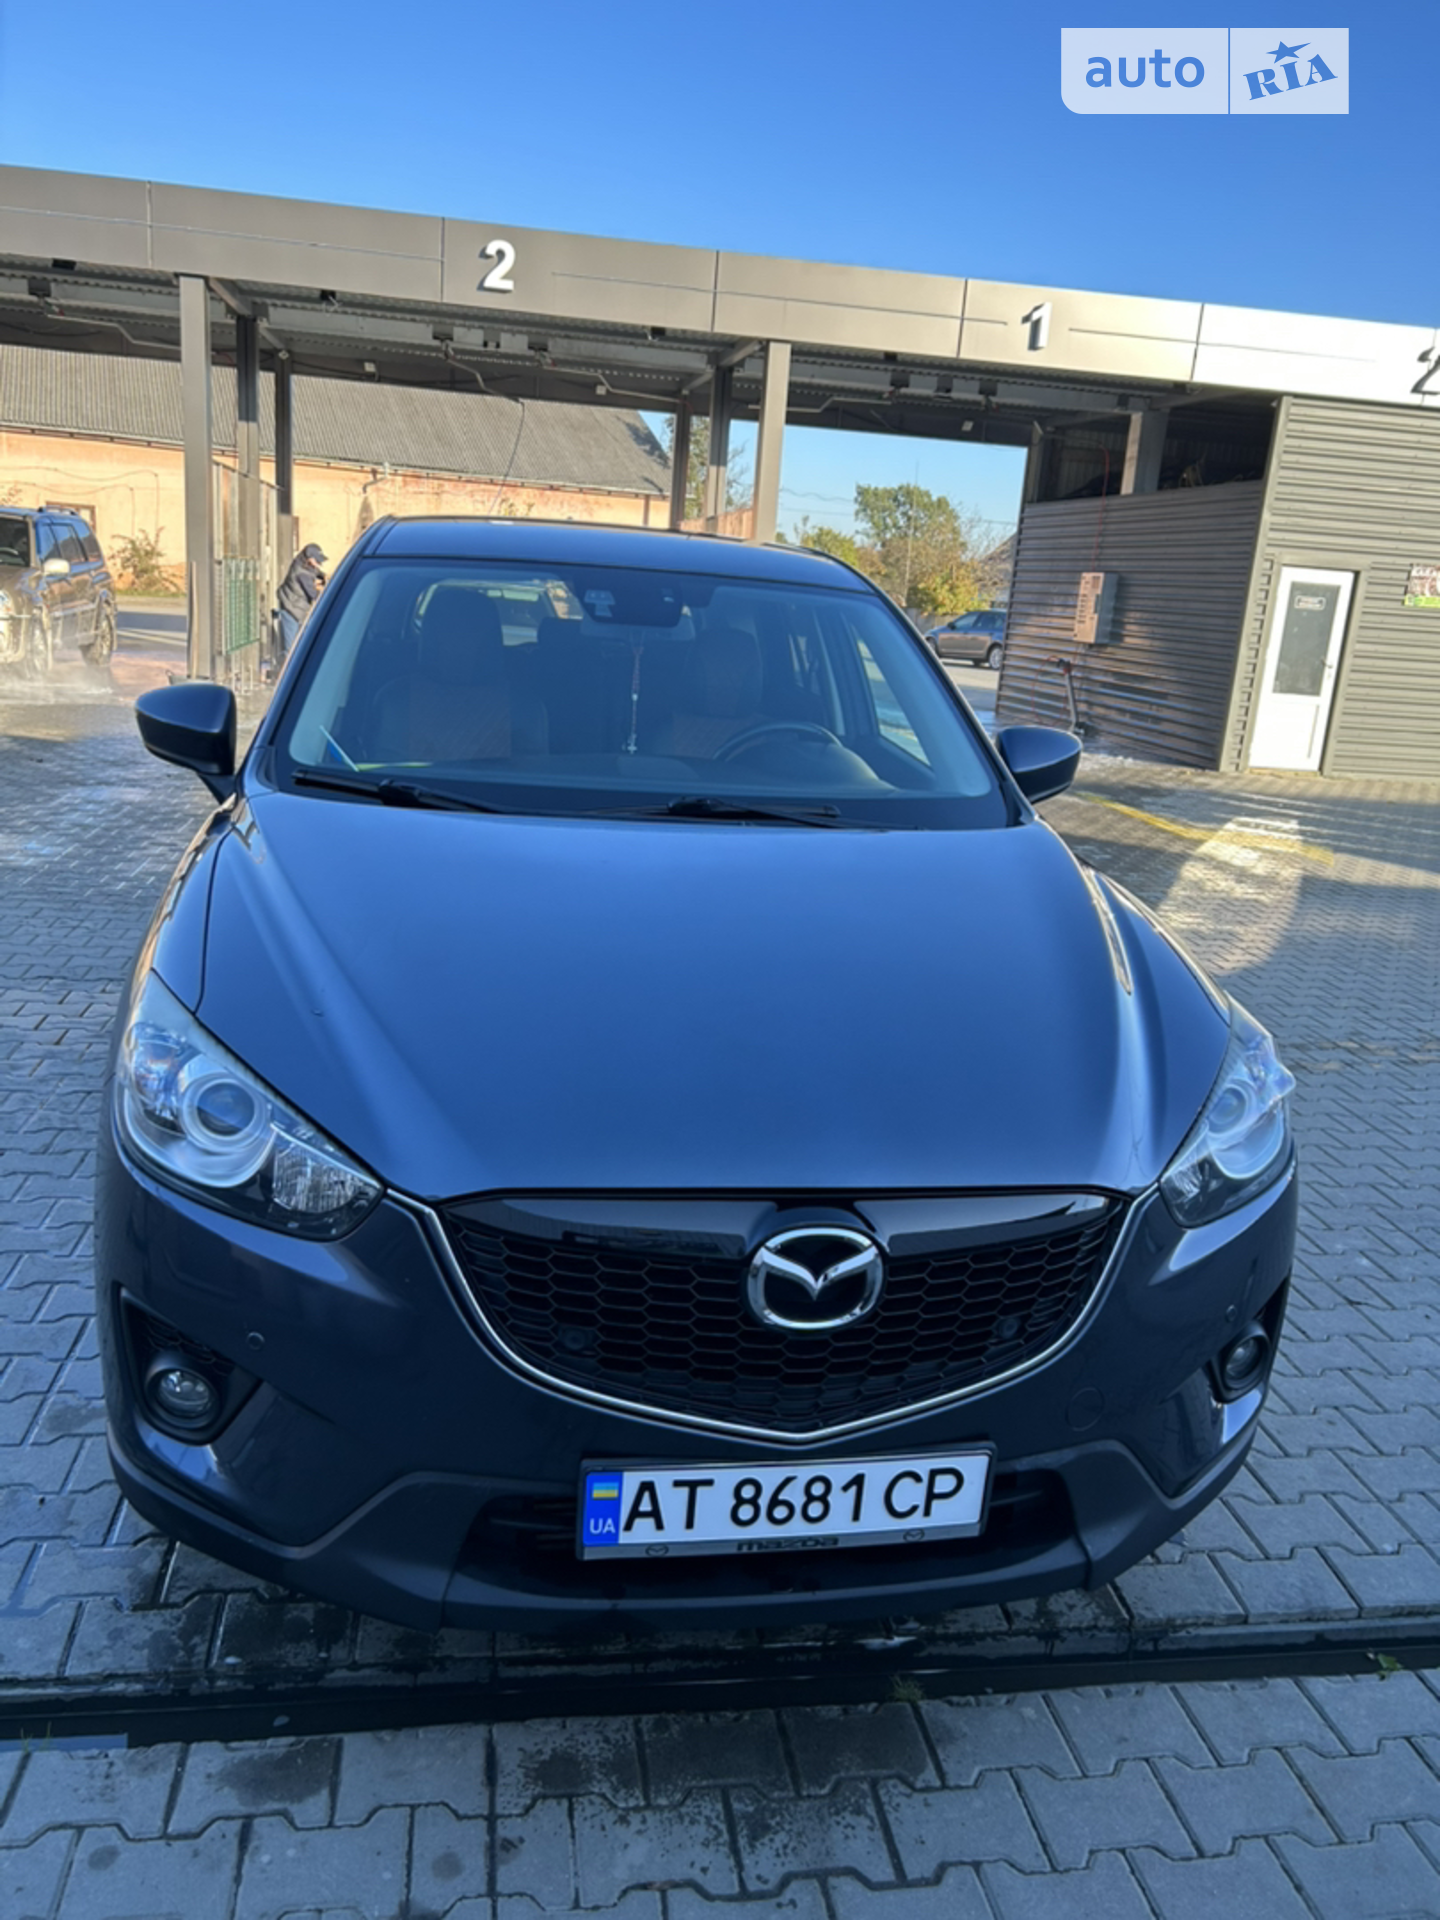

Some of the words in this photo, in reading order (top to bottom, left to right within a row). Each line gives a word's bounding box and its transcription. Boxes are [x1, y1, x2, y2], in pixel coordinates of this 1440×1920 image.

[477, 239, 516, 294] 2
[1021, 302, 1052, 351] 1
[623, 1478, 715, 1532] AT
[730, 1473, 866, 1528] 8681
[884, 1467, 964, 1520] CP
[589, 1518, 616, 1535] UA
